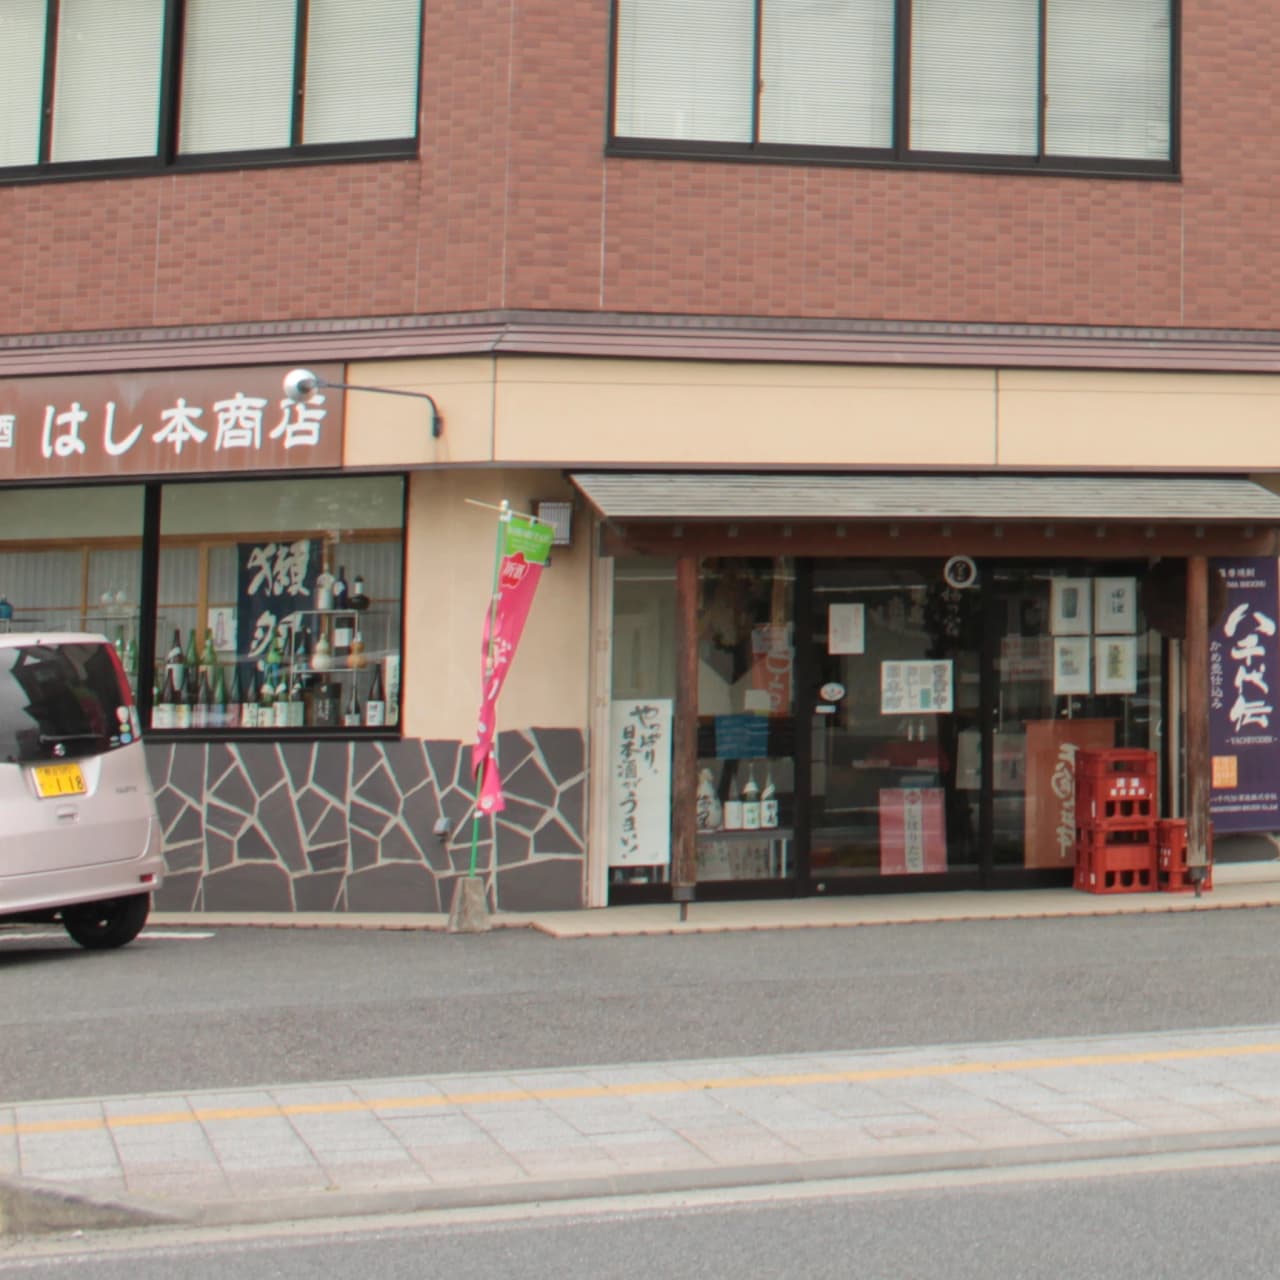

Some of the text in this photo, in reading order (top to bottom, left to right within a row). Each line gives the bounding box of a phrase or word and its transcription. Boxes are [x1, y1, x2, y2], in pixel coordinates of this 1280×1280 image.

[41, 392, 327, 458] はし本商店
[1224, 602, 1276, 733] 八千代伝
